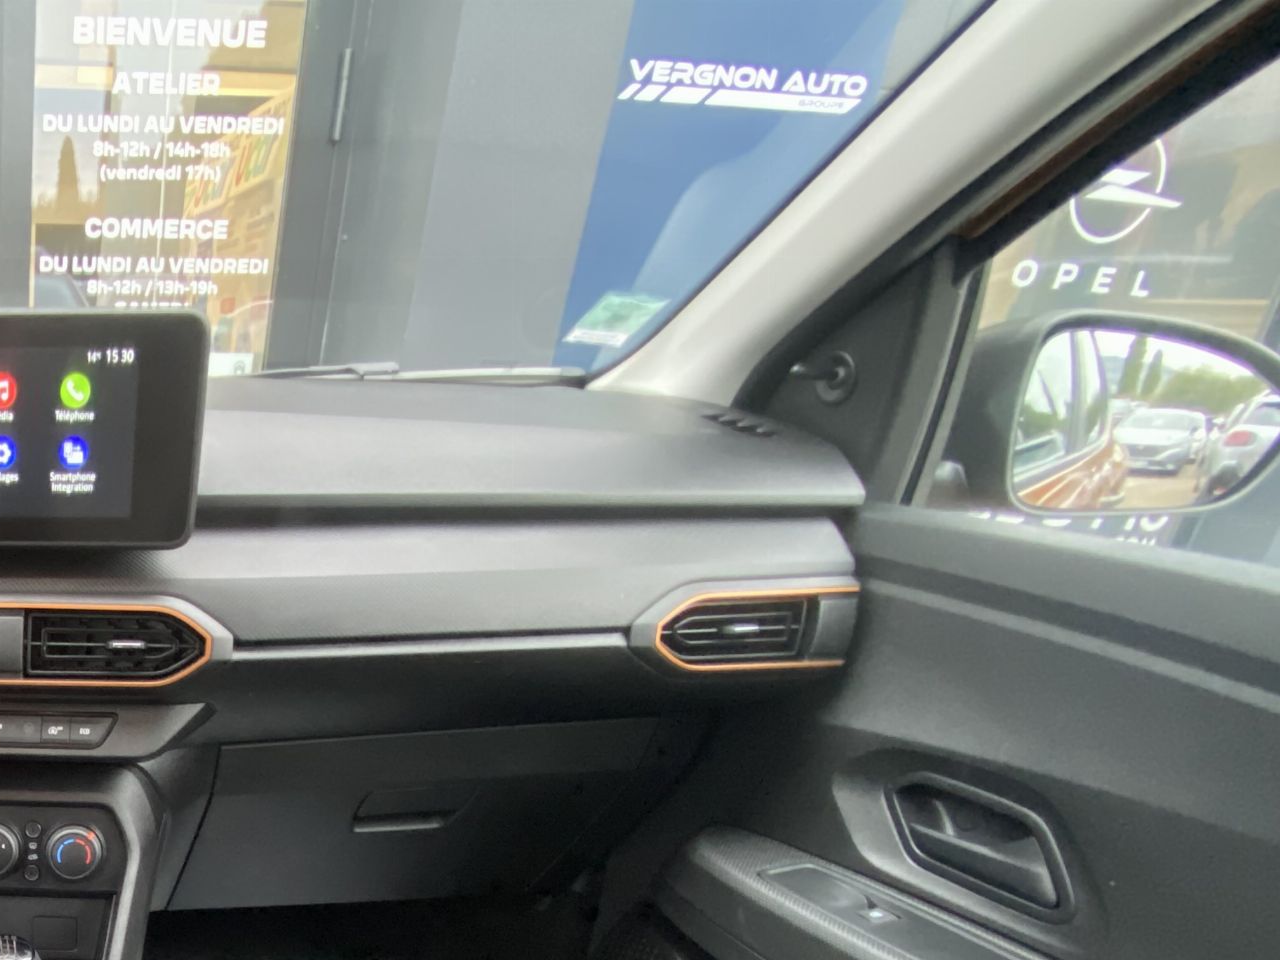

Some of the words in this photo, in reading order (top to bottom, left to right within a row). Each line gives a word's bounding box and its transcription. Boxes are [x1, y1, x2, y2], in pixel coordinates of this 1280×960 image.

[73, 16, 268, 48] BIENVENUE
[112, 71, 220, 95] ATELIER
[629, 58, 778, 91] VERGNON
[781, 70, 868, 97] AUTO
[798, 99, 845, 109] GROUPE
[42, 114, 73, 132] DU
[77, 115, 139, 133] LUNDI
[144, 116, 174, 133] AU
[179, 116, 284, 135] VENDREDI
[93, 141, 150, 159] 8h-12h
[153, 142, 161, 159] /
[165, 142, 231, 158] 14h-18h
[100, 164, 181, 181] (vendredi
[185, 164, 221, 183] 17h)
[85, 217, 229, 240] COMMERCE
[39, 256, 67, 273] DU
[72, 256, 131, 274] LUNDI
[135, 257, 165, 273] AU
[169, 257, 269, 275] VENDREDI
[1011, 258, 1150, 298] OPEL
[87, 280, 141, 295] 8h-12h
[144, 280, 152, 297] /
[156, 280, 218, 295] 13h-19h
[55, 410, 95, 423] Téléphone
[50, 471, 96, 484] Smartphone
[51, 482, 94, 494] Integration
